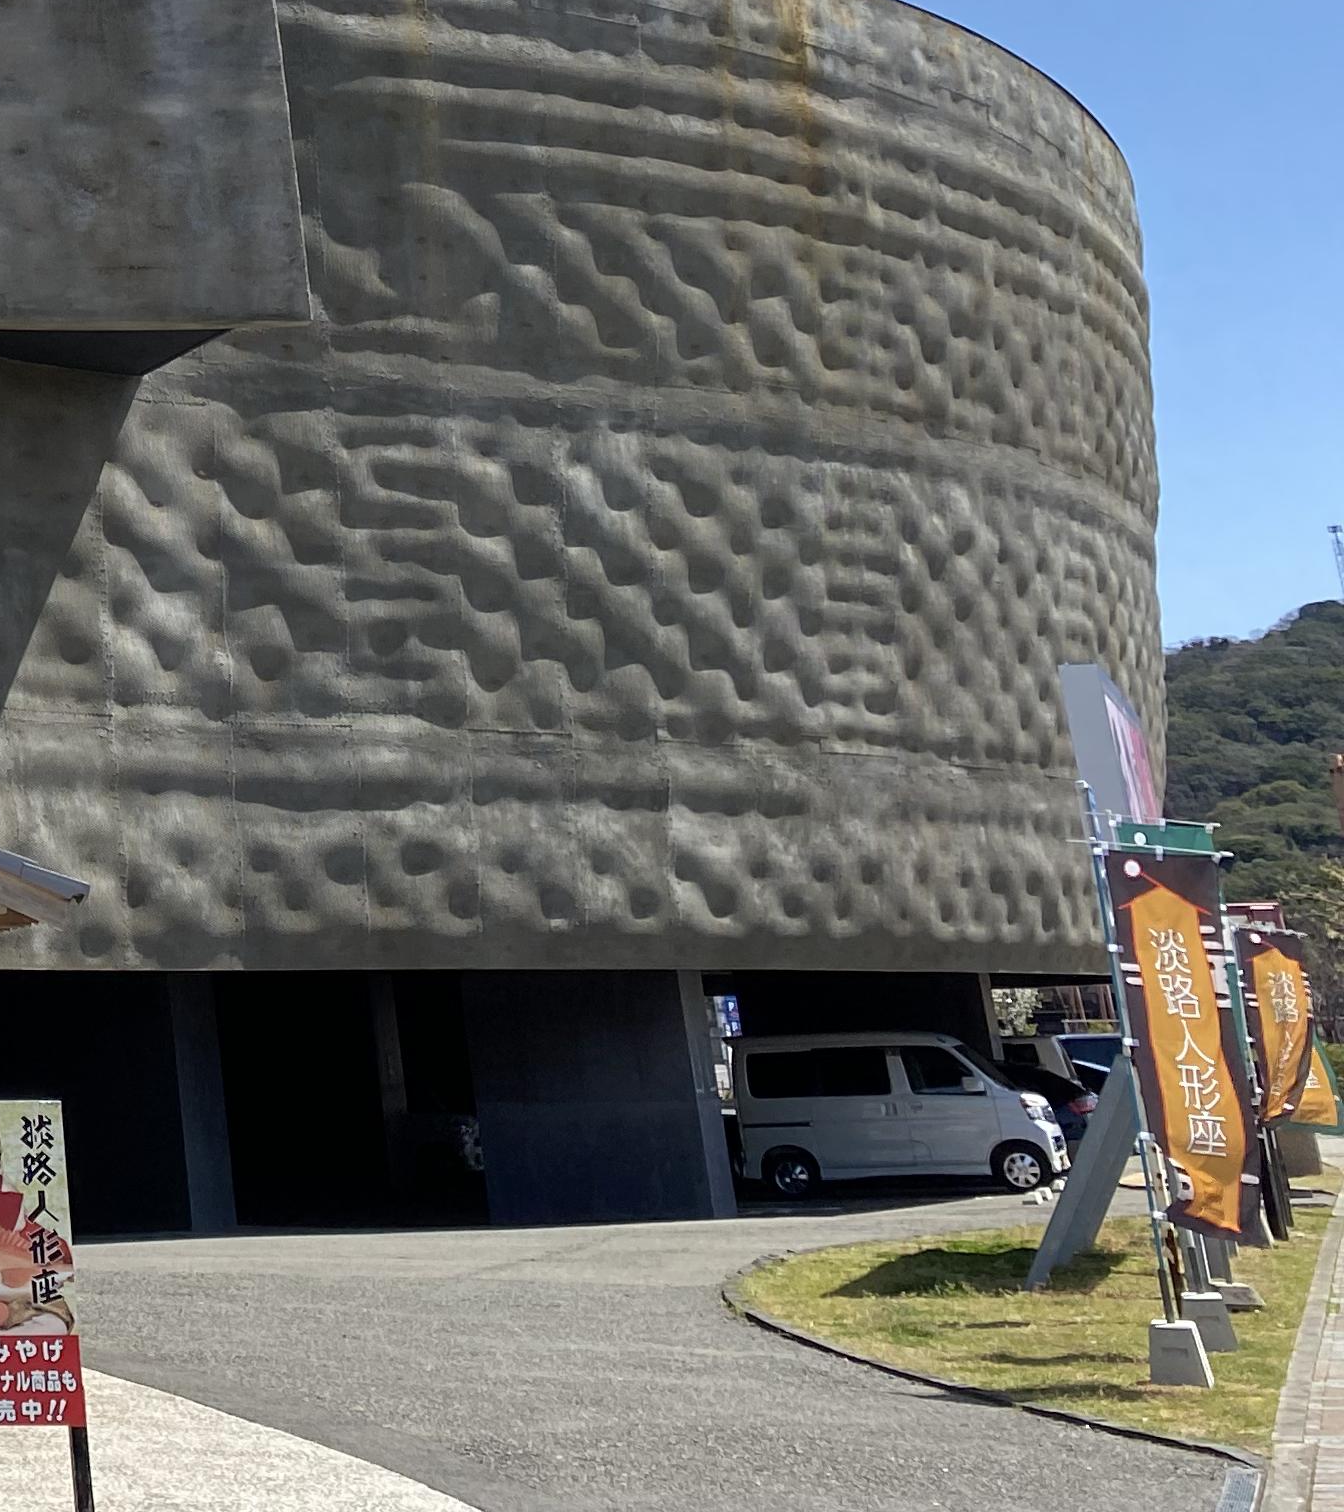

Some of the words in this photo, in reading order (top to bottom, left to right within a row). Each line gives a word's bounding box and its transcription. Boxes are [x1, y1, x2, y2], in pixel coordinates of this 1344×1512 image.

[1147, 927, 1227, 1157] 淡路人形座
[20, 1114, 63, 1304] 淡路人形座
